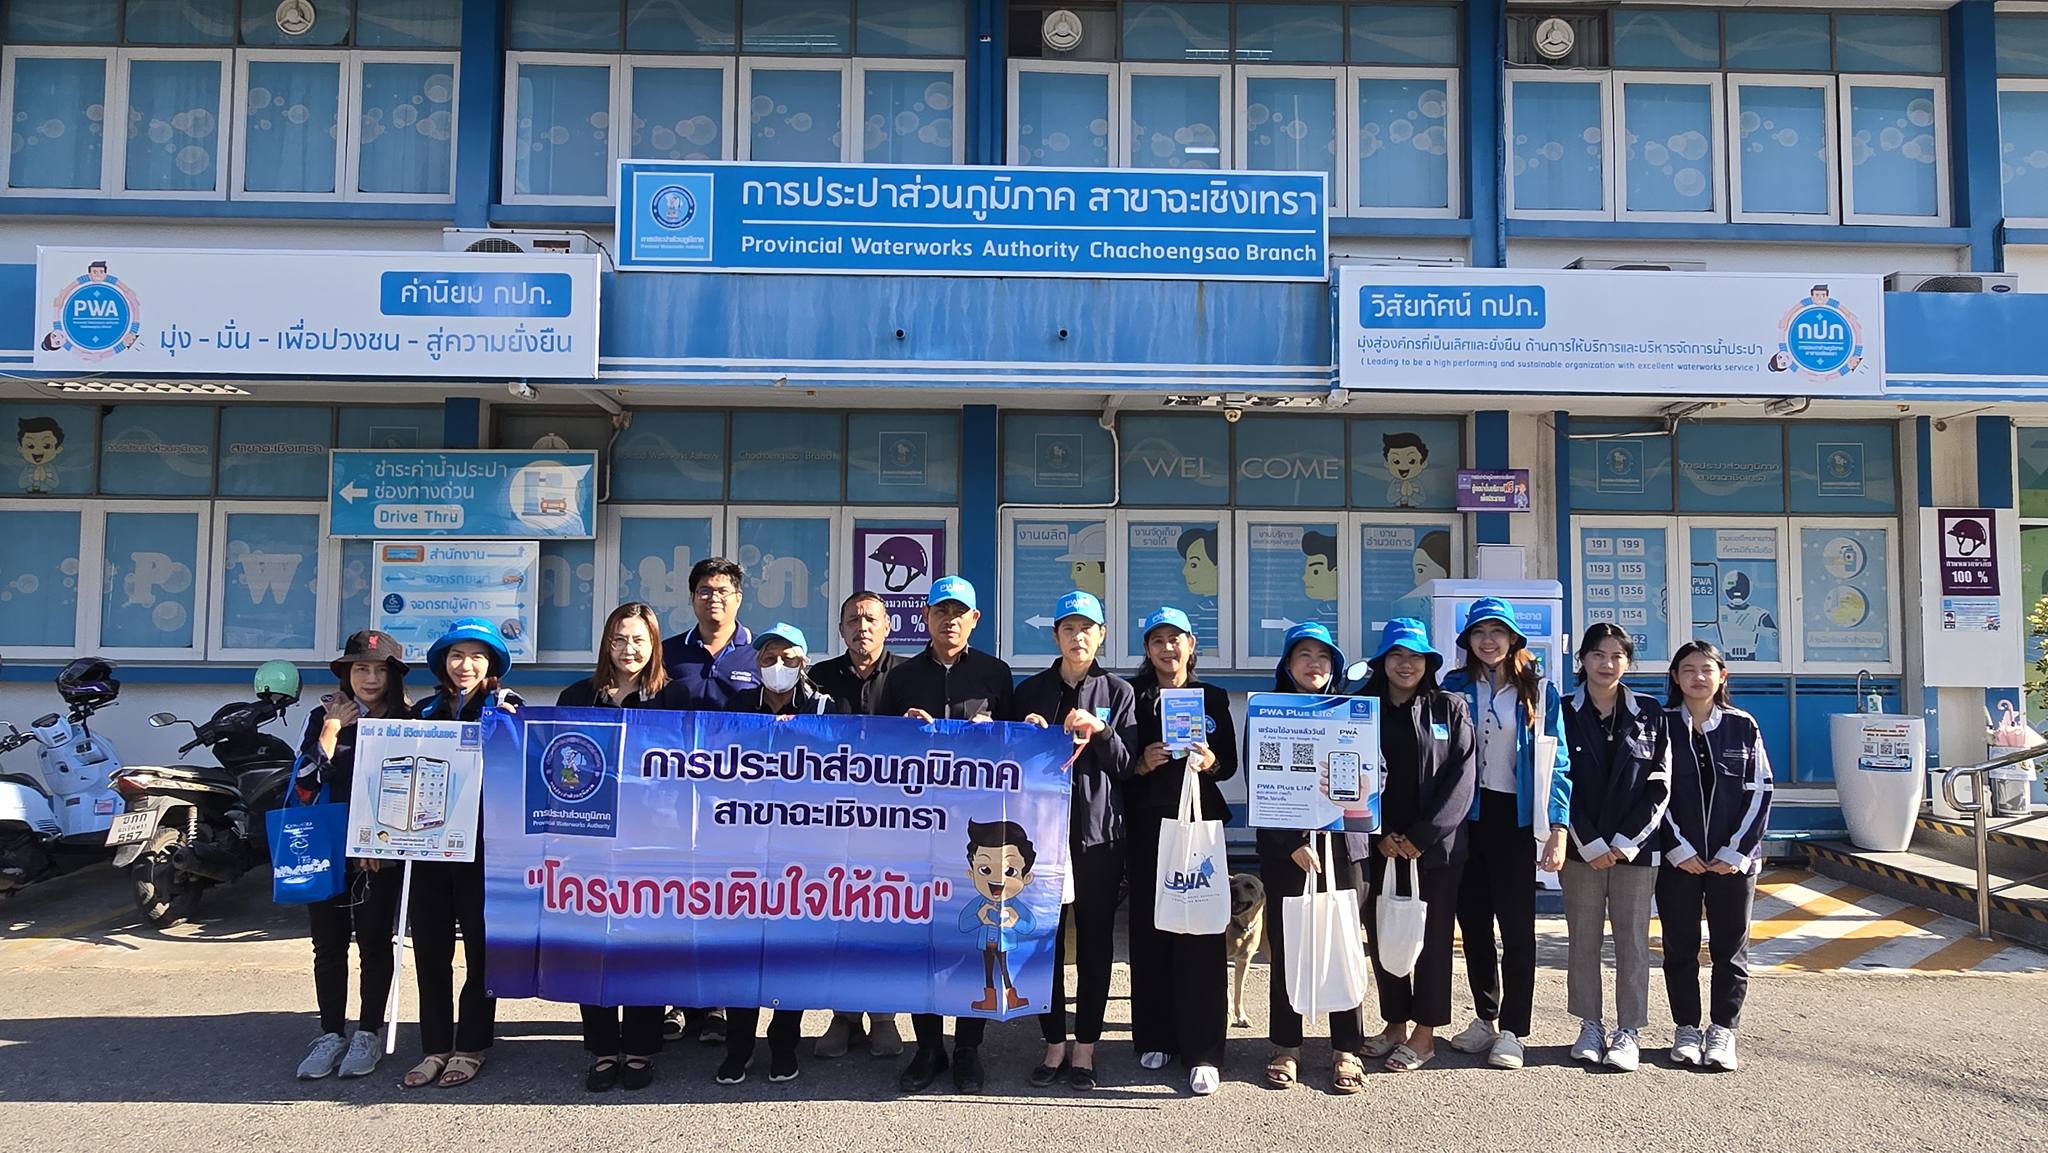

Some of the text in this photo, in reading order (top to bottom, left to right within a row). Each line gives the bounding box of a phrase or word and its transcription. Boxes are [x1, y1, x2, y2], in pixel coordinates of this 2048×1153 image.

[742, 174, 1317, 222] การประปาส่วนภูมิภาค สาขาฉะเชิงเทรา
[741, 236, 1317, 264] Provincial Waterworks Authority Chachoengsao Branch
[401, 277, 552, 305] ค่านิยม กปภ.
[73, 299, 119, 317] PWA
[1371, 292, 1539, 318] วิสัยทัศน์ กปภ.
[1798, 319, 1844, 340] กปภ
[160, 324, 191, 357] มุ่ง
[217, 319, 250, 350] มั่น
[278, 318, 400, 352] เพื่อปวงชน
[427, 322, 572, 361] สู่ความยั่งยืน
[1357, 334, 1763, 356] มุ่งสู่องค์กรที่เป็นเลิศและยั่งยืน ด้านการให้บริการและบริหารจัดการน้ำประปา
[1367, 358, 1398, 368] Leading
[1413, 358, 1423, 366] be
[1434, 359, 1451, 369] high
[1453, 360, 1497, 369] performing
[1501, 360, 1515, 368] and
[1518, 360, 1562, 369] sustainable
[1565, 361, 1615, 371] organization
[1618, 362, 1635, 370] with
[1638, 362, 1674, 370] excellent
[1678, 363, 1722, 371] waterworks
[1725, 364, 1753, 372] service
[375, 455, 507, 478] ชำระค่าน้ำประปา
[1142, 456, 1340, 480] WEL COME
[375, 481, 475, 500] ช่องทางด่วน
[379, 511, 459, 524] Drive Thru
[1019, 528, 1067, 541] งานผลิต
[1591, 540, 1640, 548] 191 199
[429, 548, 485, 560] สำนักงาน
[1590, 564, 1642, 573] 1193 1155
[1951, 570, 1989, 583] 100 %
[1590, 586, 1644, 596] 1146 1356
[1692, 578, 1712, 586] PWA
[1589, 610, 1642, 618] 1669 1154
[1259, 708, 1282, 716] PWA
[1286, 709, 1309, 717] Plus
[378, 728, 384, 736] 2
[642, 744, 1021, 795] การประปาส่วนภูมิภาค
[532, 808, 612, 822] การประปาส่วนภูมิภาค
[714, 799, 947, 831] สาขาฉะเชิงเทรา
[527, 860, 950, 921] "โครงการเติมใจให้กัน"
